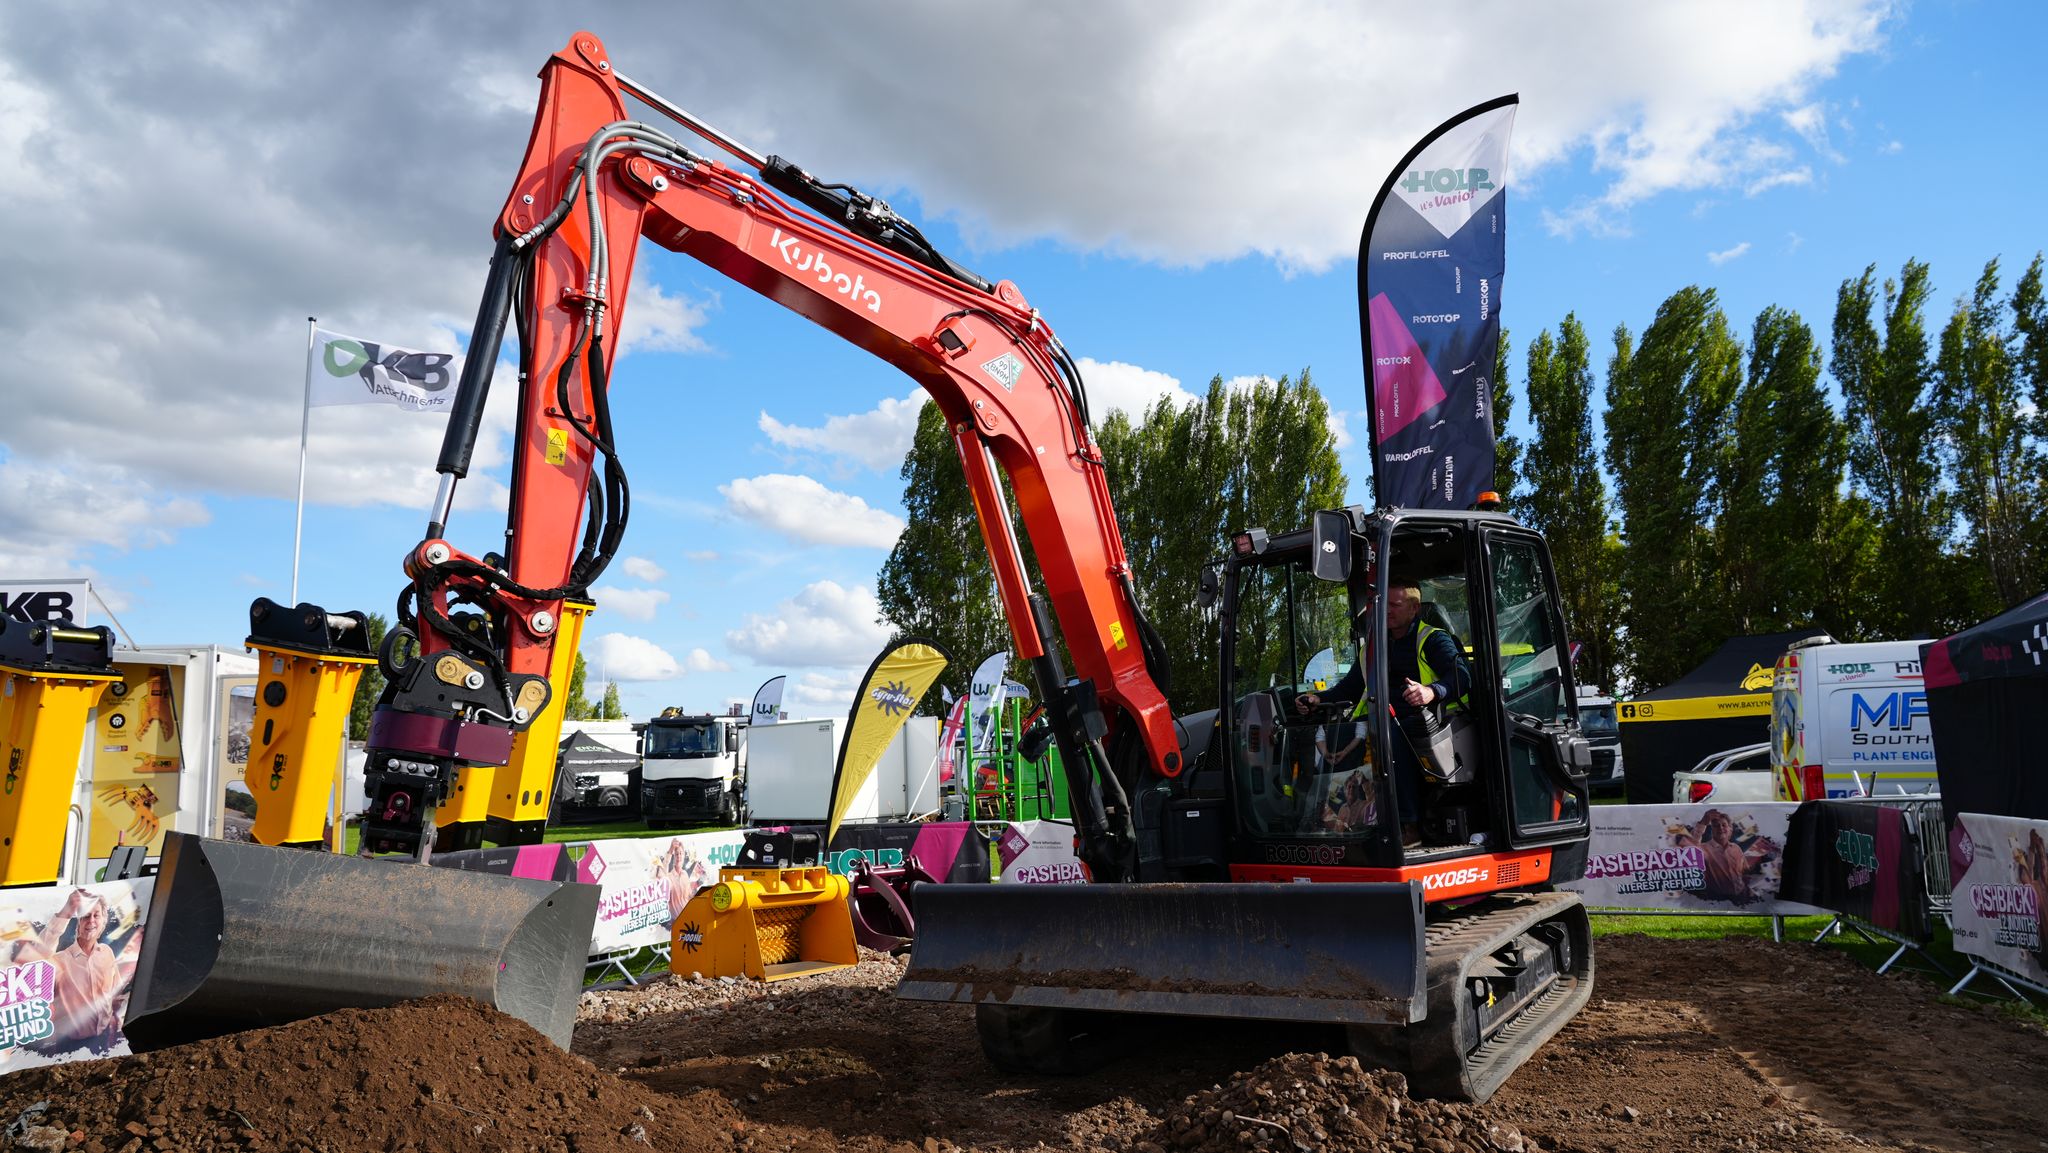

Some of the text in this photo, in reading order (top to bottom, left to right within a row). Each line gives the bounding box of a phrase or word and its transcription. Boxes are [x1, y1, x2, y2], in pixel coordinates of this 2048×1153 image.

[1406, 168, 1490, 193] HOLP
[1435, 188, 1475, 207] Vario!
[770, 228, 882, 314] Kubota
[1480, 279, 1489, 321] QUICKON
[1413, 314, 1460, 324] ROTOTOP
[1377, 356, 1411, 366] ROTOX
[1444, 456, 1454, 501] MULTIGRIP
[0, 592, 73, 622] KB
[1852, 733, 1931, 745] SOUTH
[1853, 752, 1897, 761] PLANT
[1265, 844, 1345, 864] ROTOTOP
[1422, 867, 1489, 890] KX085-5
[1633, 868, 1700, 882] 12 MONTHS
[1663, 878, 1702, 891] REFUND
[597, 879, 669, 917] CASHBACK!
[1970, 883, 2034, 915] CASHBACK!
